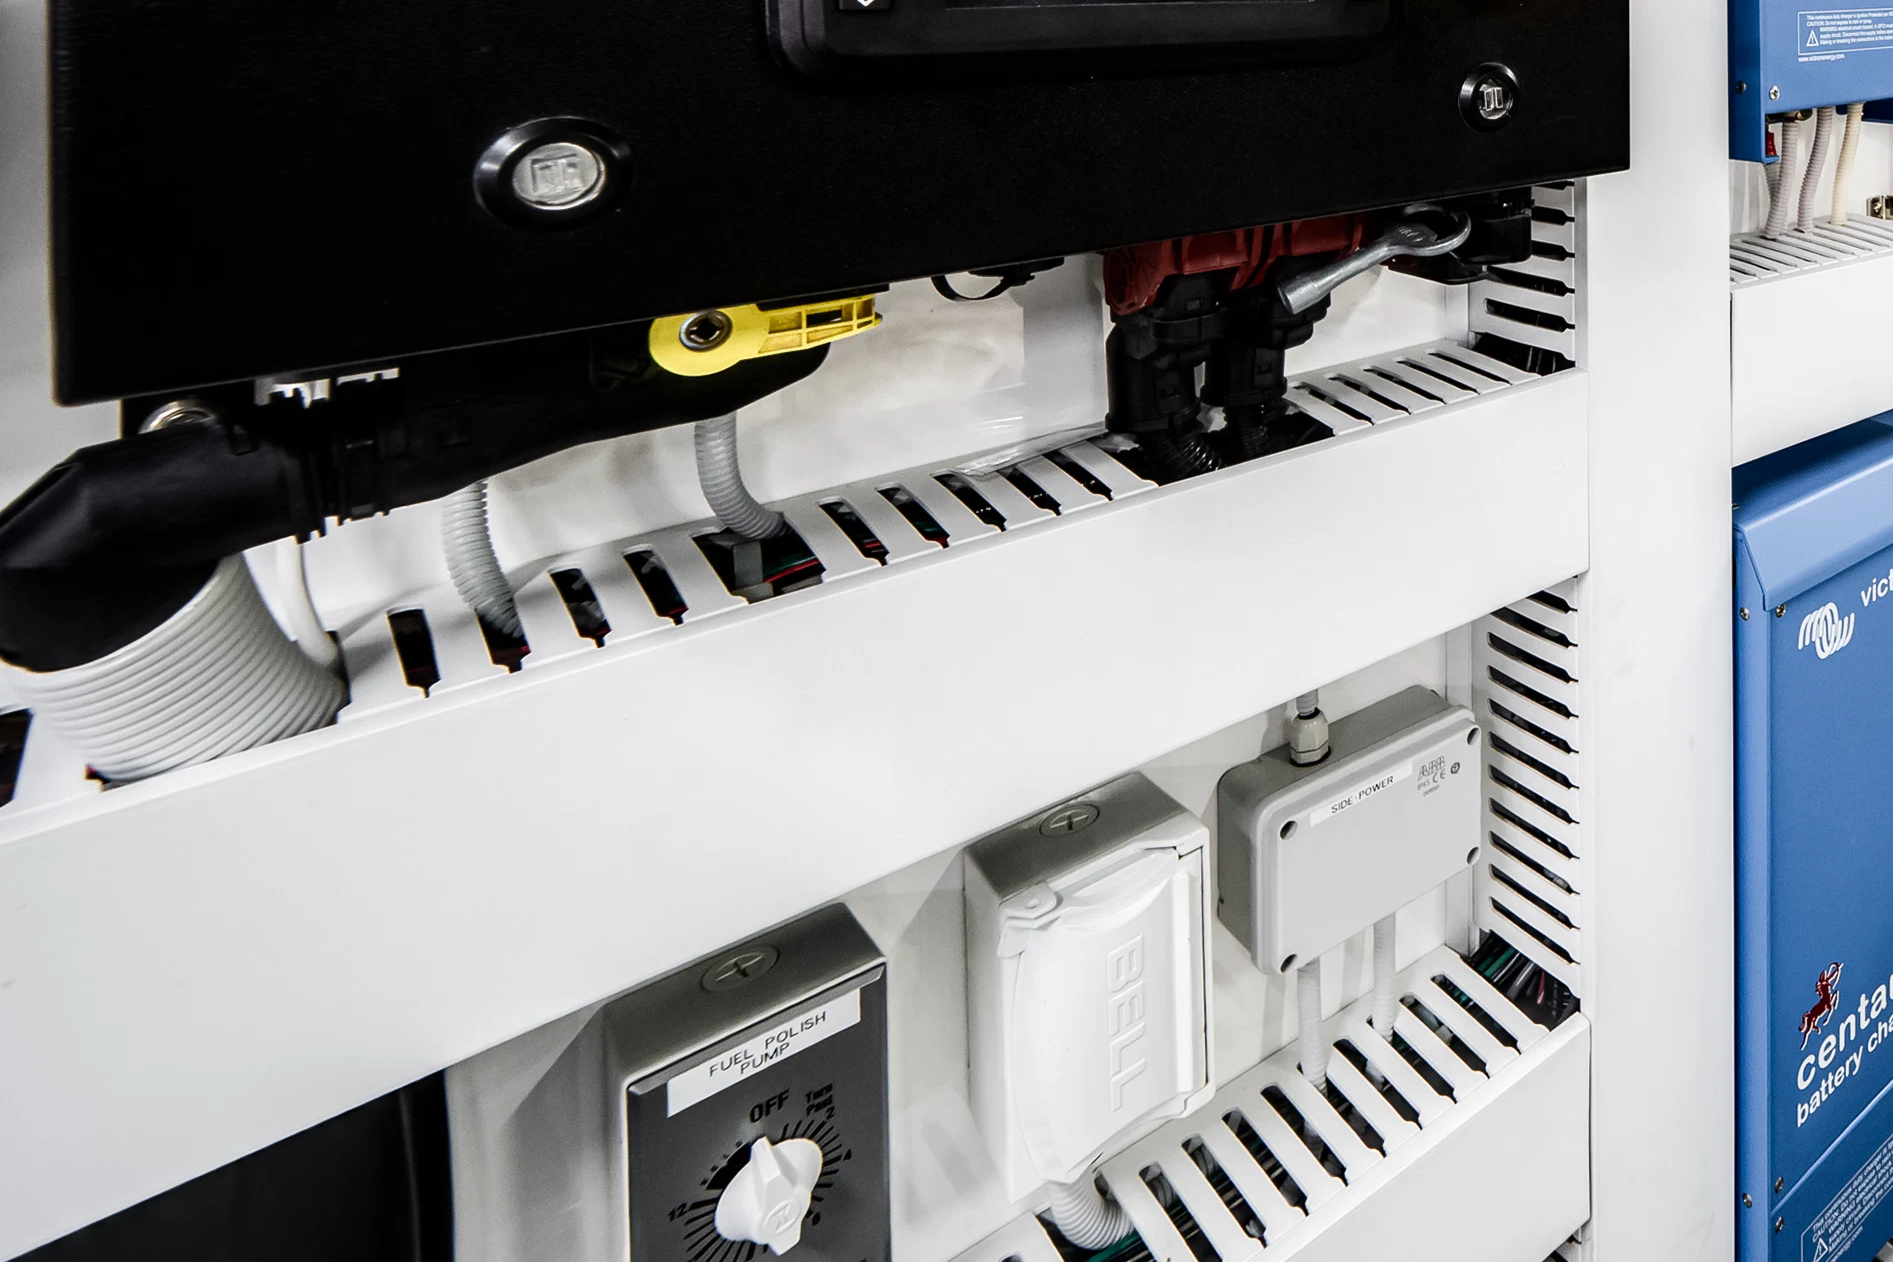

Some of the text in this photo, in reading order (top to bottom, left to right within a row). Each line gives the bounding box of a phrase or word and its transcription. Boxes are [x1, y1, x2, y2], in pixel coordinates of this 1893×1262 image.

[1106, 933, 1147, 1114] BELL
[709, 1010, 827, 1078] FUEL POLISH
[740, 1041, 791, 1076] PUMP
[1796, 1045, 1864, 1129] battery
[750, 1089, 790, 1124] OFF
[826, 1105, 836, 1121] 2
[668, 1204, 689, 1223] 12
